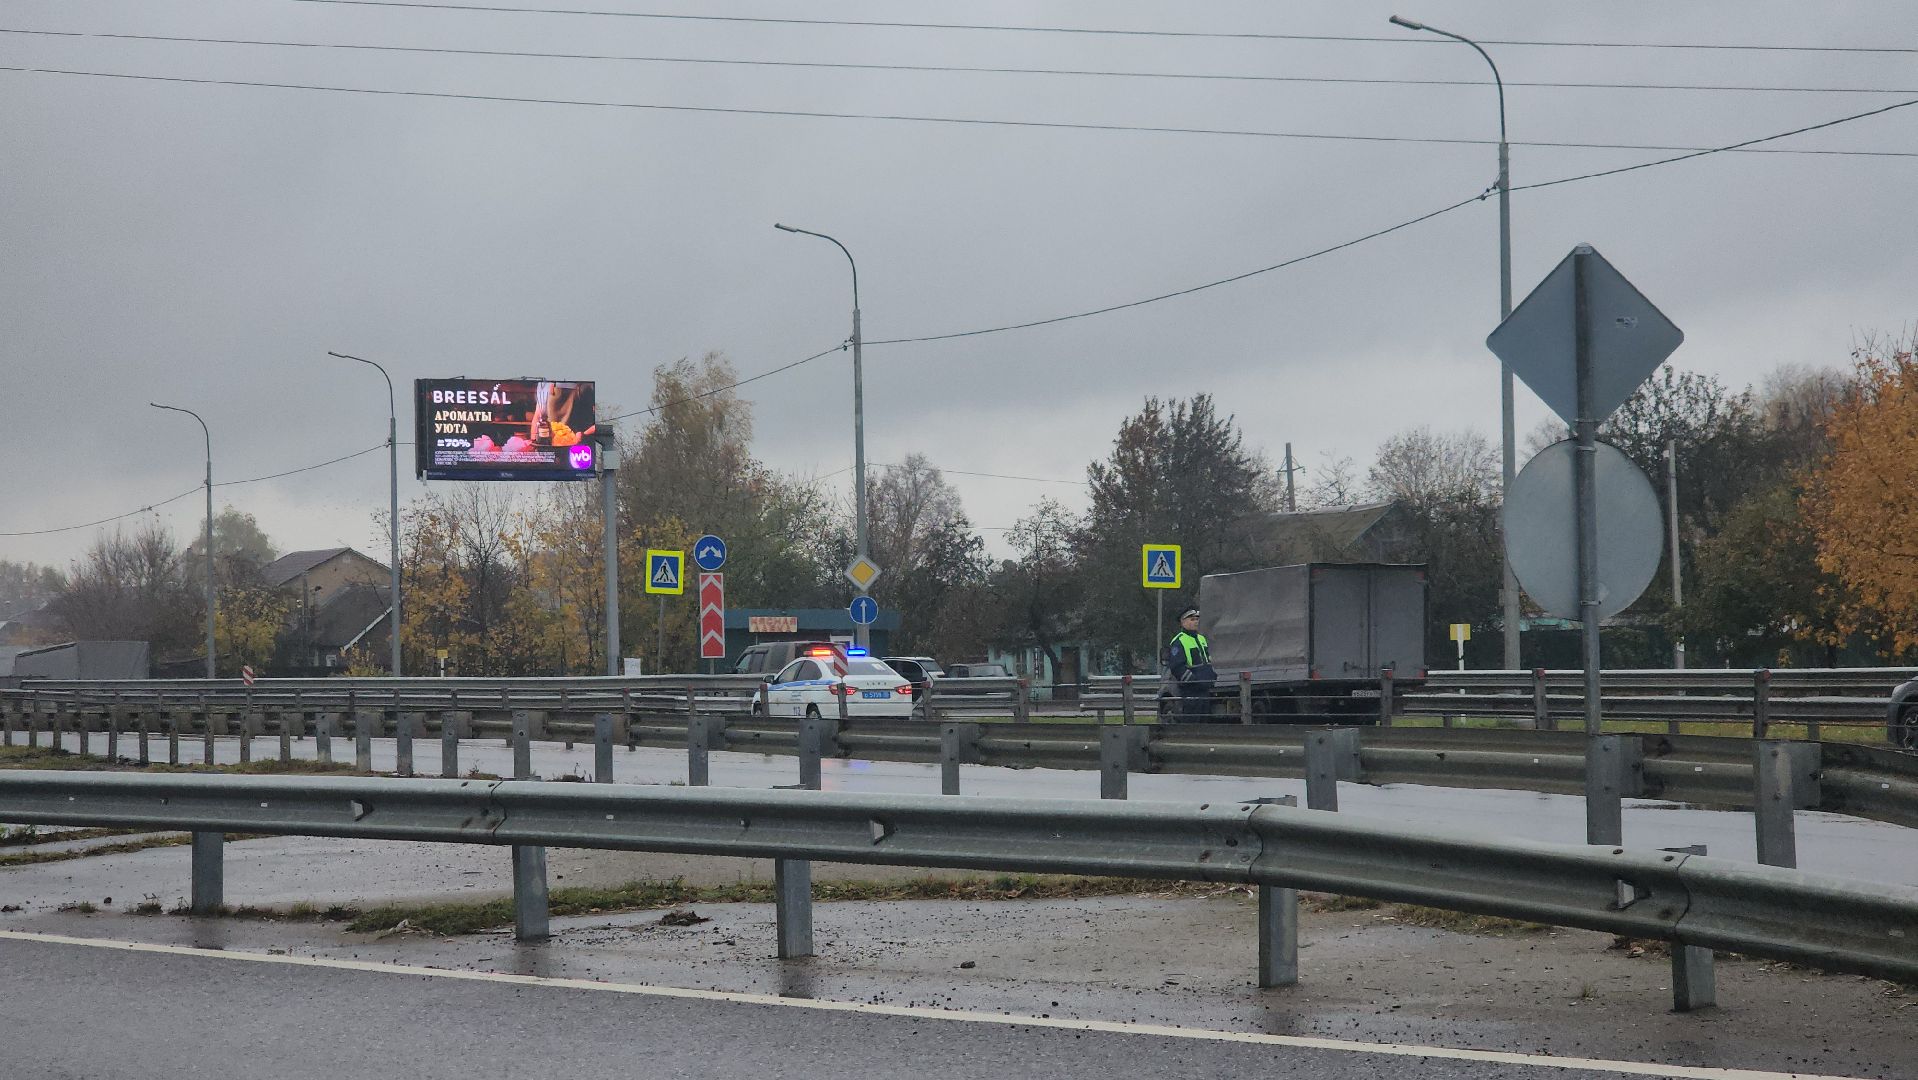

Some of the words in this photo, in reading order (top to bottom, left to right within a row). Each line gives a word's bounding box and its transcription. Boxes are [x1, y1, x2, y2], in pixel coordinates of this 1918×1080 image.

[435, 411, 492, 422] АРОМАТЫ
[435, 423, 468, 434] УЮТА
[571, 450, 590, 462] wb
